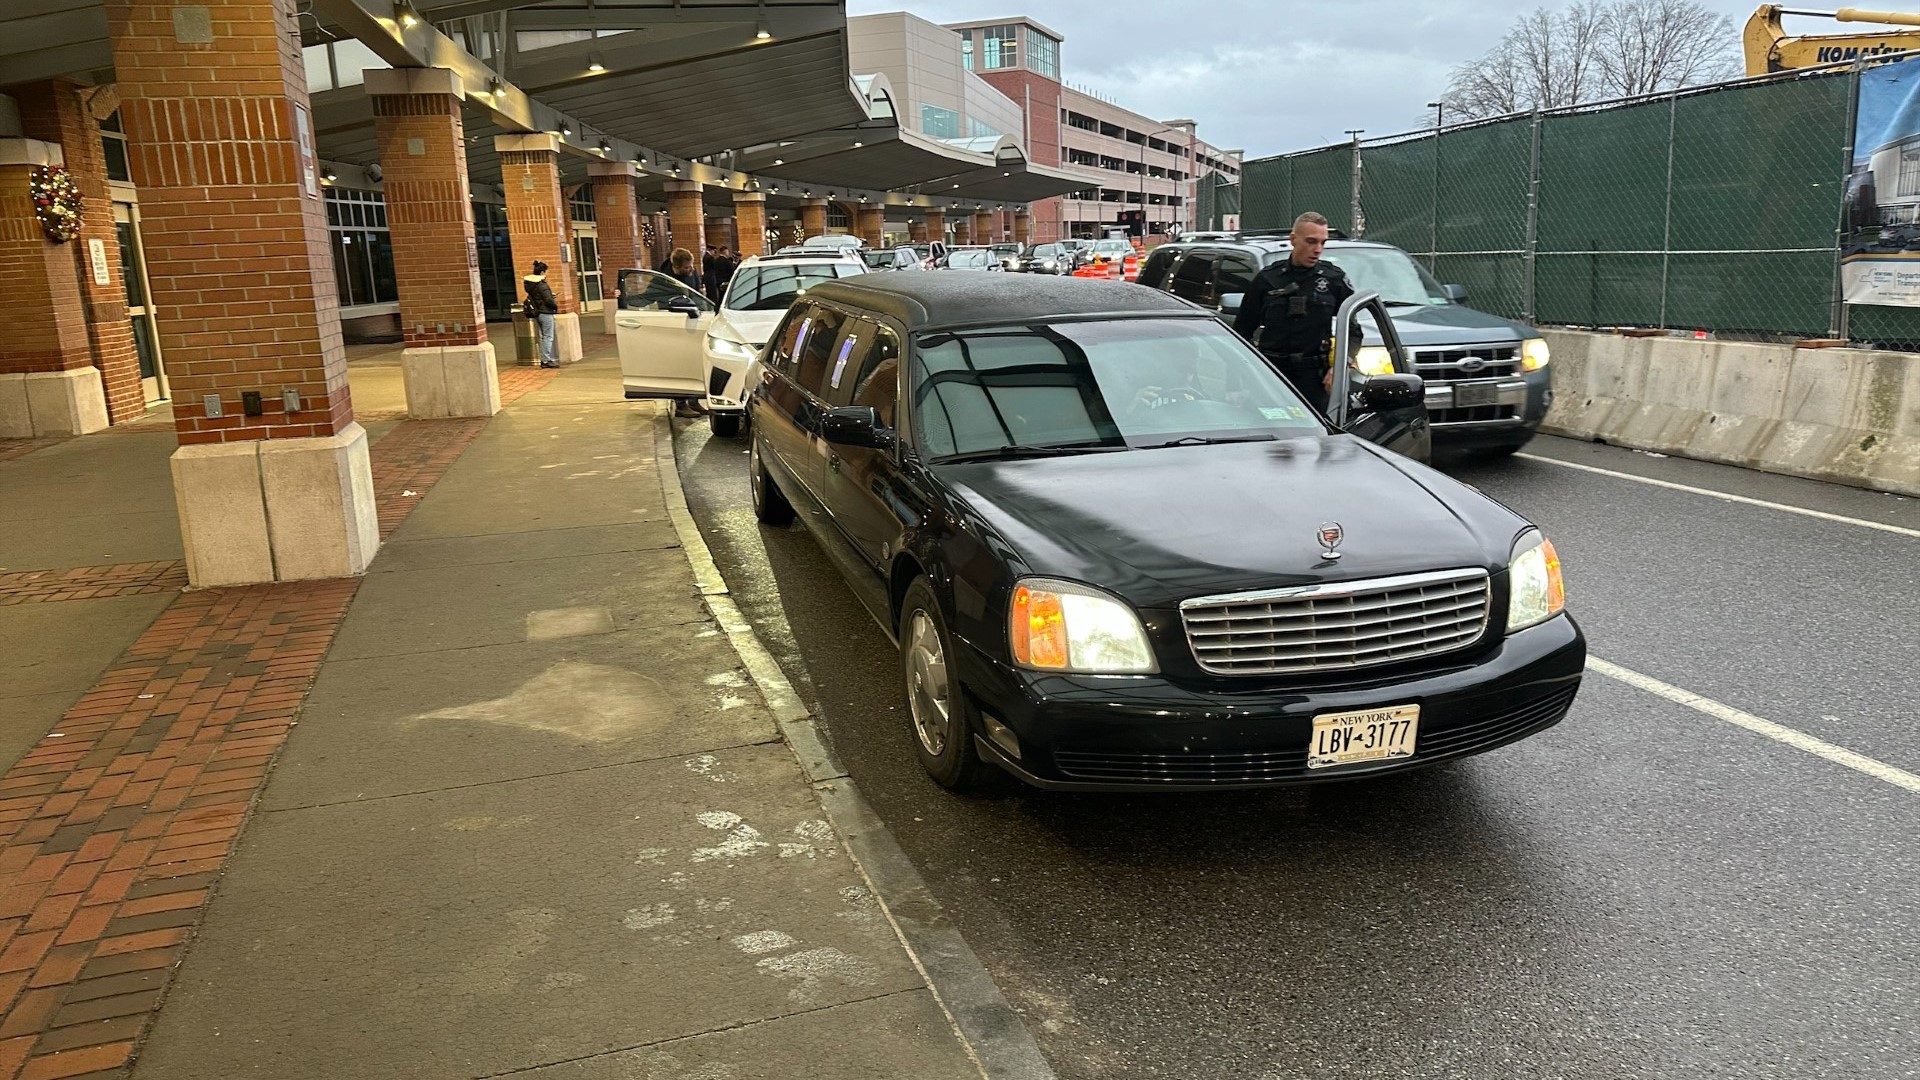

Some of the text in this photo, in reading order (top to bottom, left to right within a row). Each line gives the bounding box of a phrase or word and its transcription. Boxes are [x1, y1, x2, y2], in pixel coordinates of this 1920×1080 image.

[1340, 711, 1394, 726] NEW YORK
[1318, 720, 1411, 755] LBV 3177
